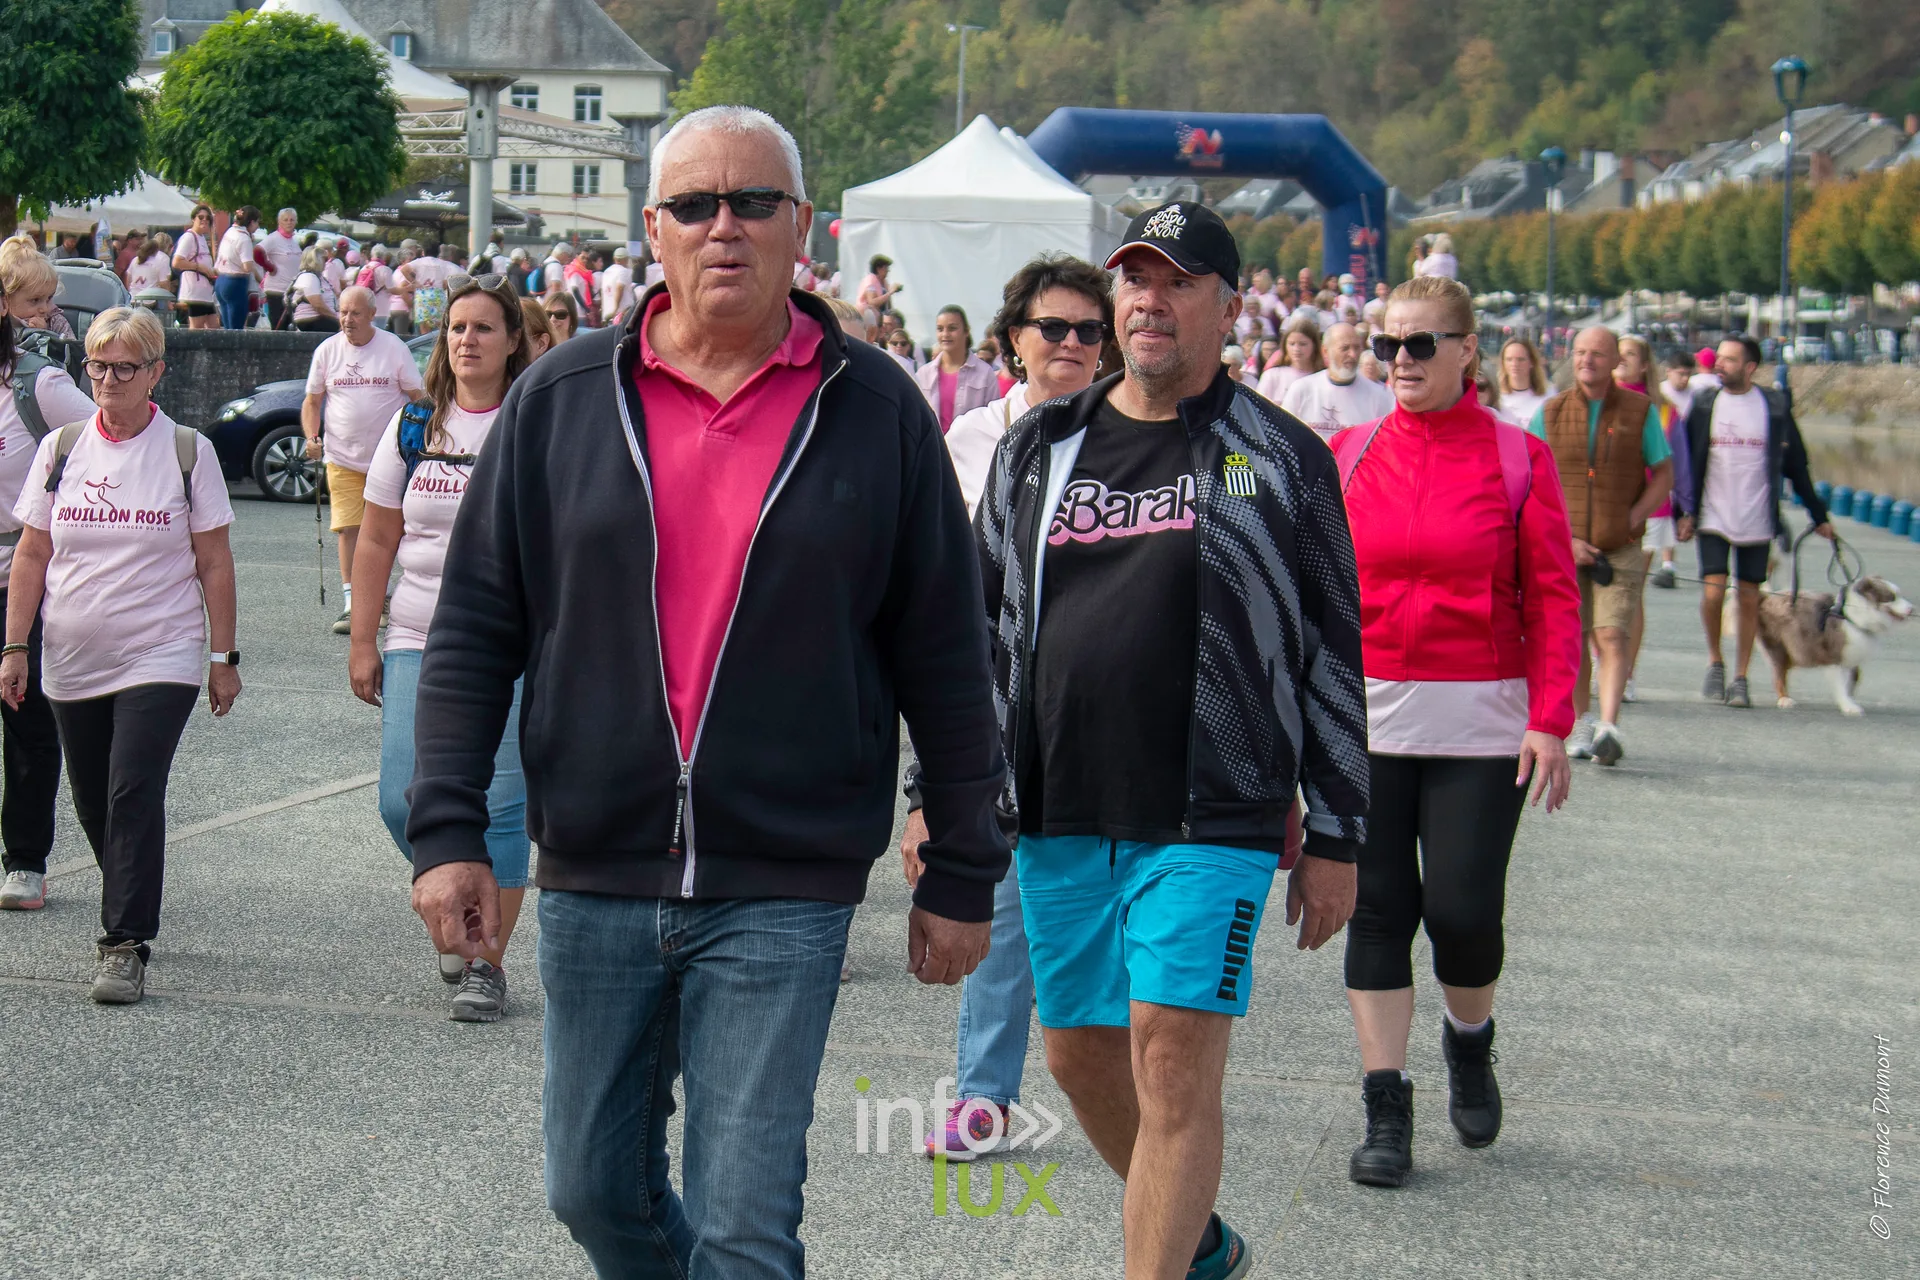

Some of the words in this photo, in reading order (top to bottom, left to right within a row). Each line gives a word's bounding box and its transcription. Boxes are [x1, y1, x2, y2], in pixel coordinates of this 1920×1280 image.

[1141, 225, 1183, 240] SAVOIE
[333, 377, 371, 386] BOUILLON
[372, 376, 390, 385] ROSE
[57, 506, 131, 523] BOUILLON
[135, 509, 171, 525] ROSE
